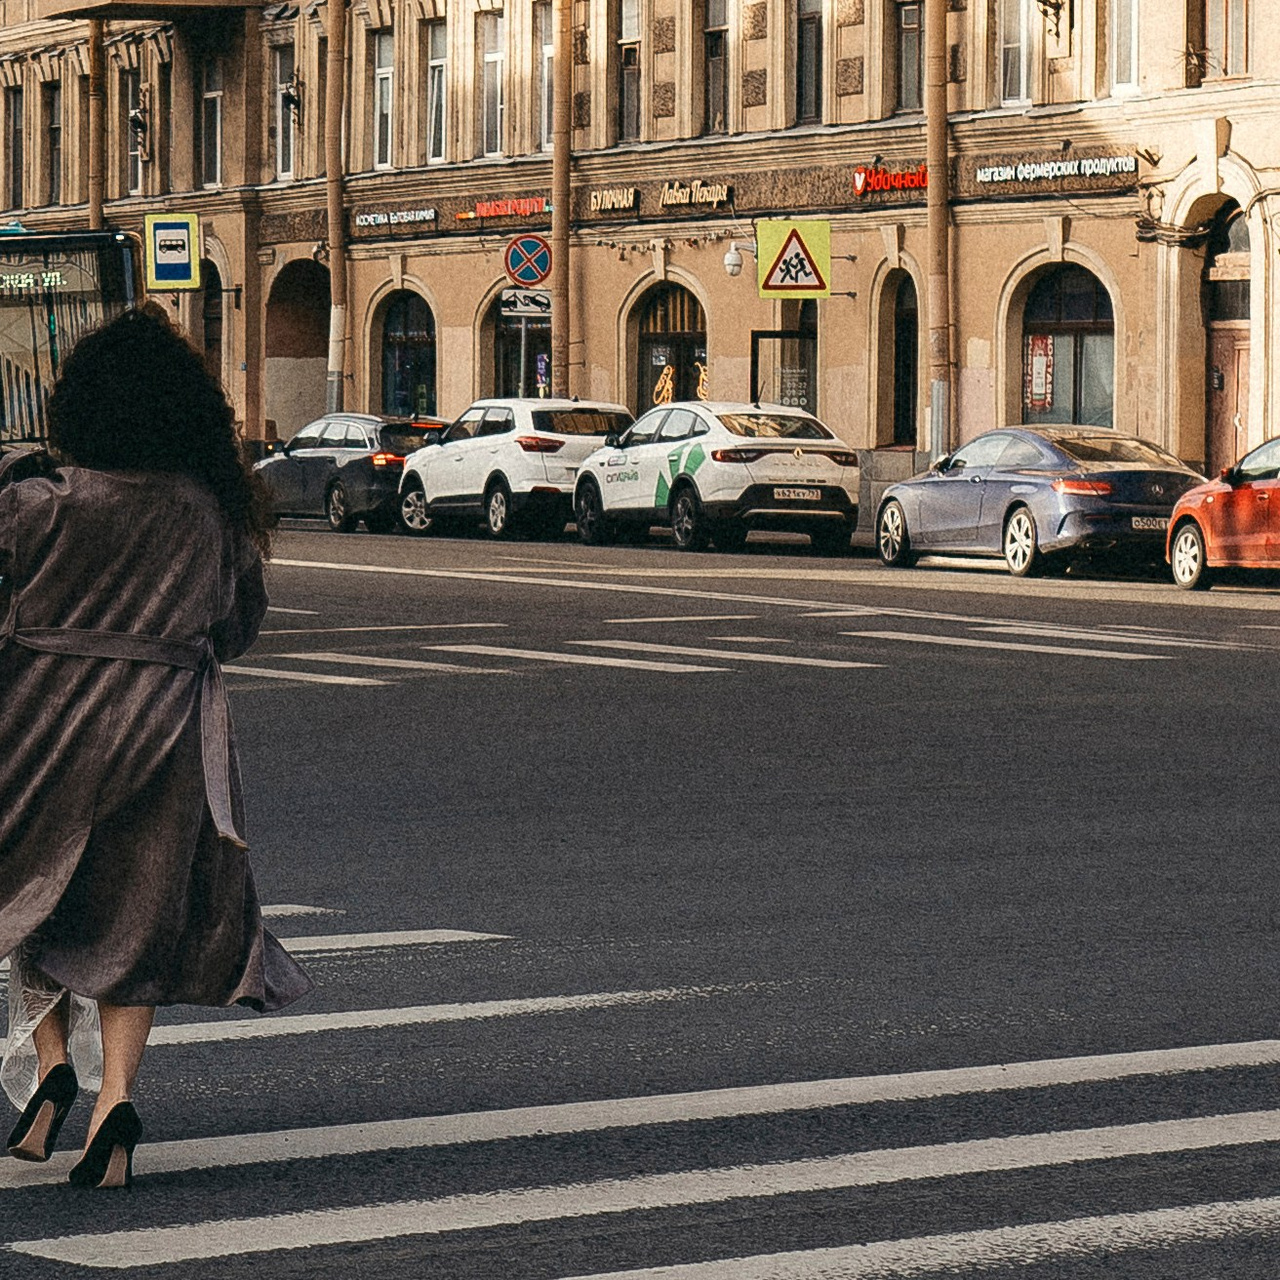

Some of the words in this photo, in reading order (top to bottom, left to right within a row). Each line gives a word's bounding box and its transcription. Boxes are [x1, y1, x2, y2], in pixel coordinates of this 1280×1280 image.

[976, 165, 1015, 183] магазин
[1017, 160, 1079, 182] фермерских
[1081, 156, 1135, 177] продуктов
[590, 187, 635, 211] БУЛОЧНАЯ
